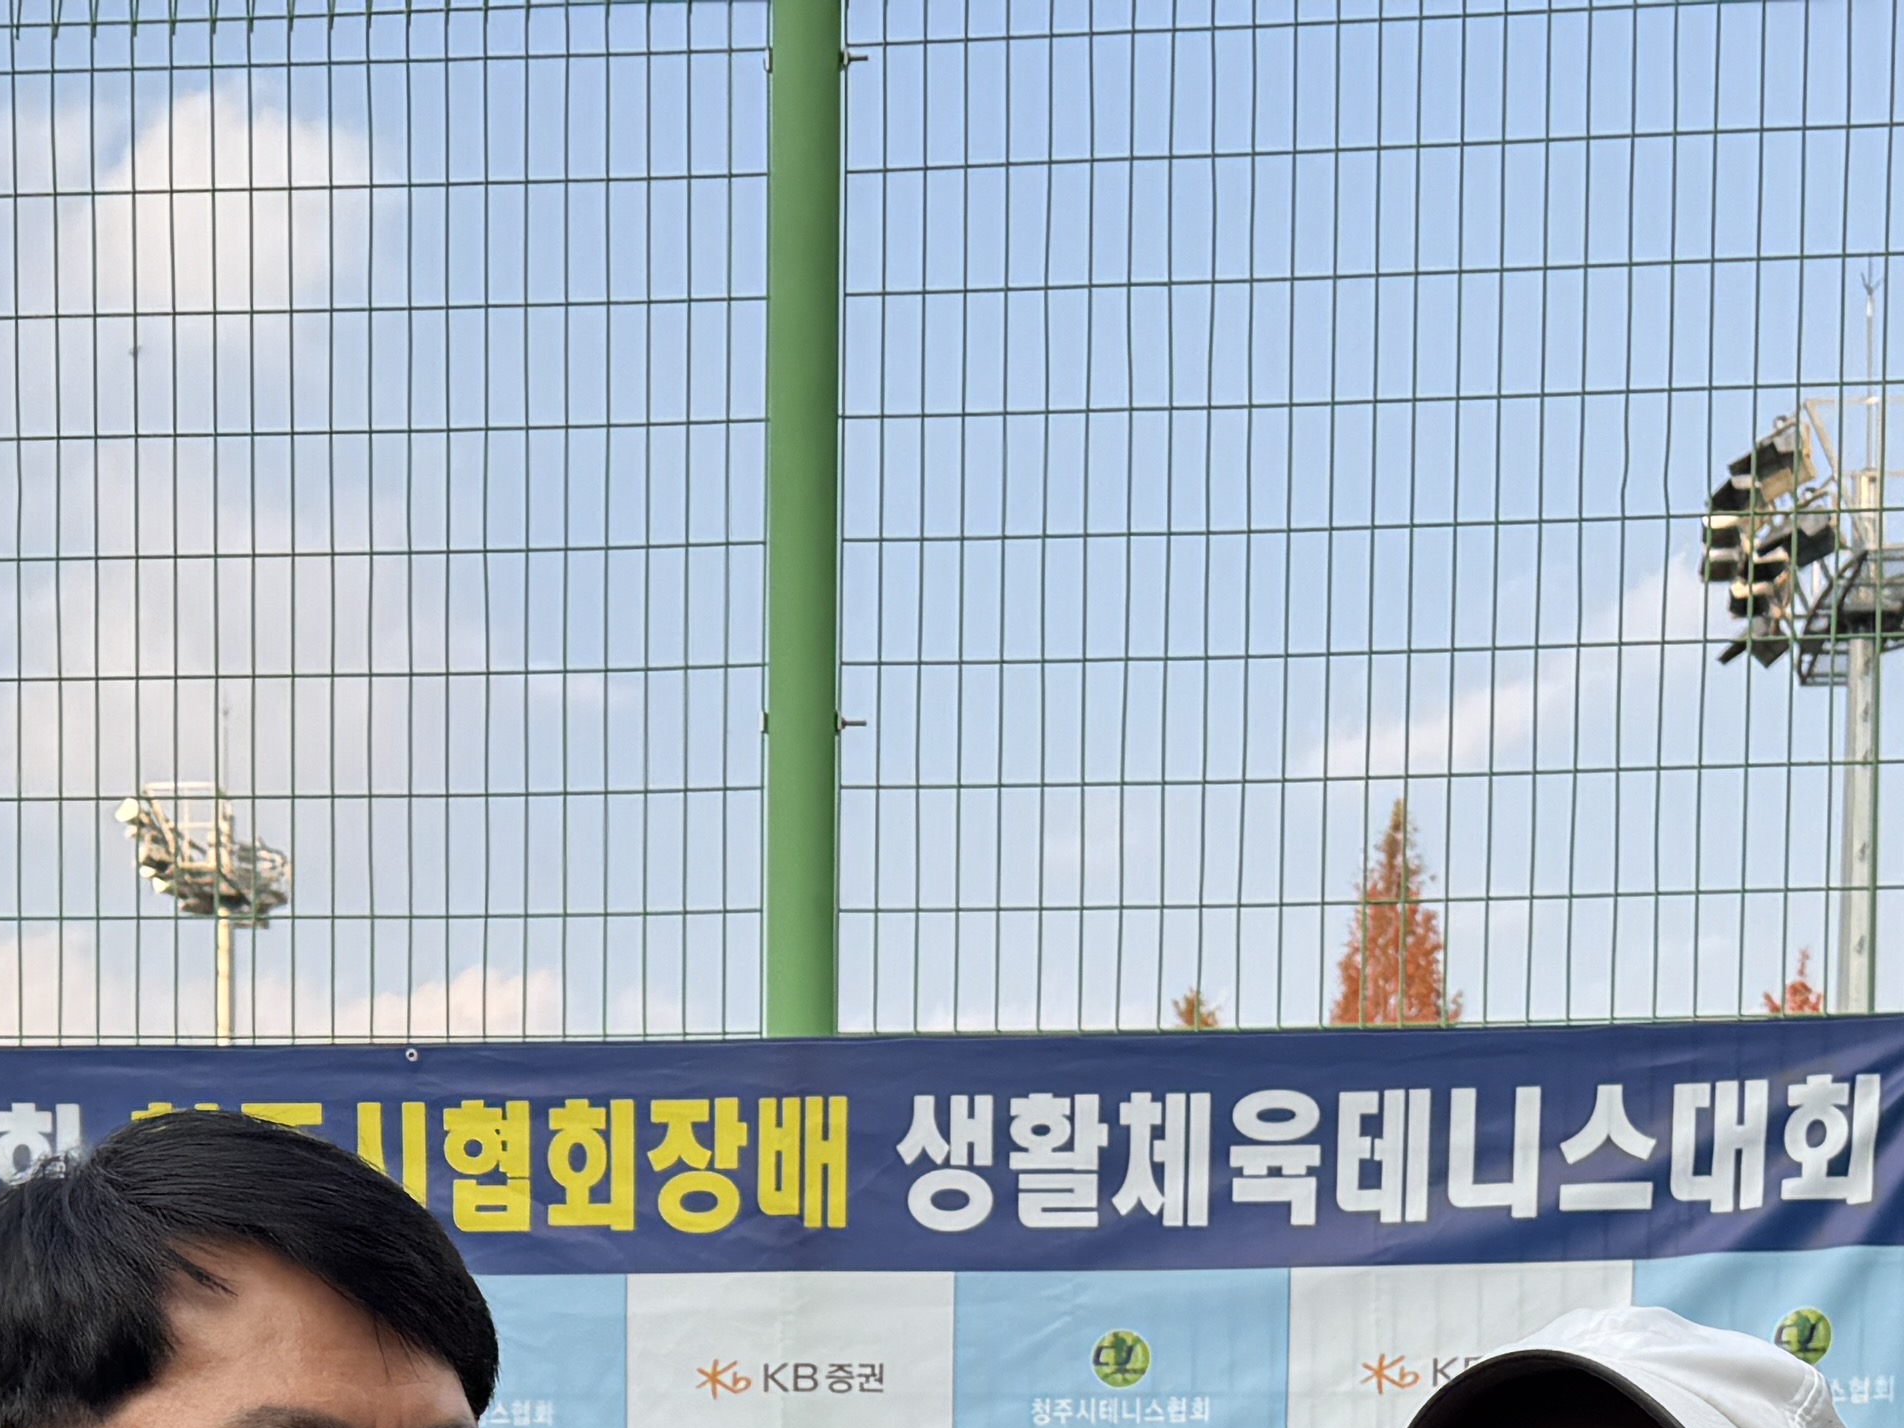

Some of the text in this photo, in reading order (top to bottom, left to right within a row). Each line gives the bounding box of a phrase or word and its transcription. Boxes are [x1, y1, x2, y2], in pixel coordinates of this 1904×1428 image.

[130, 1095, 848, 1234] 시협회장배
[894, 1072, 1882, 1234] 생활체육테니스대회
[1031, 1396, 1211, 1426] 청주시테니스협회
